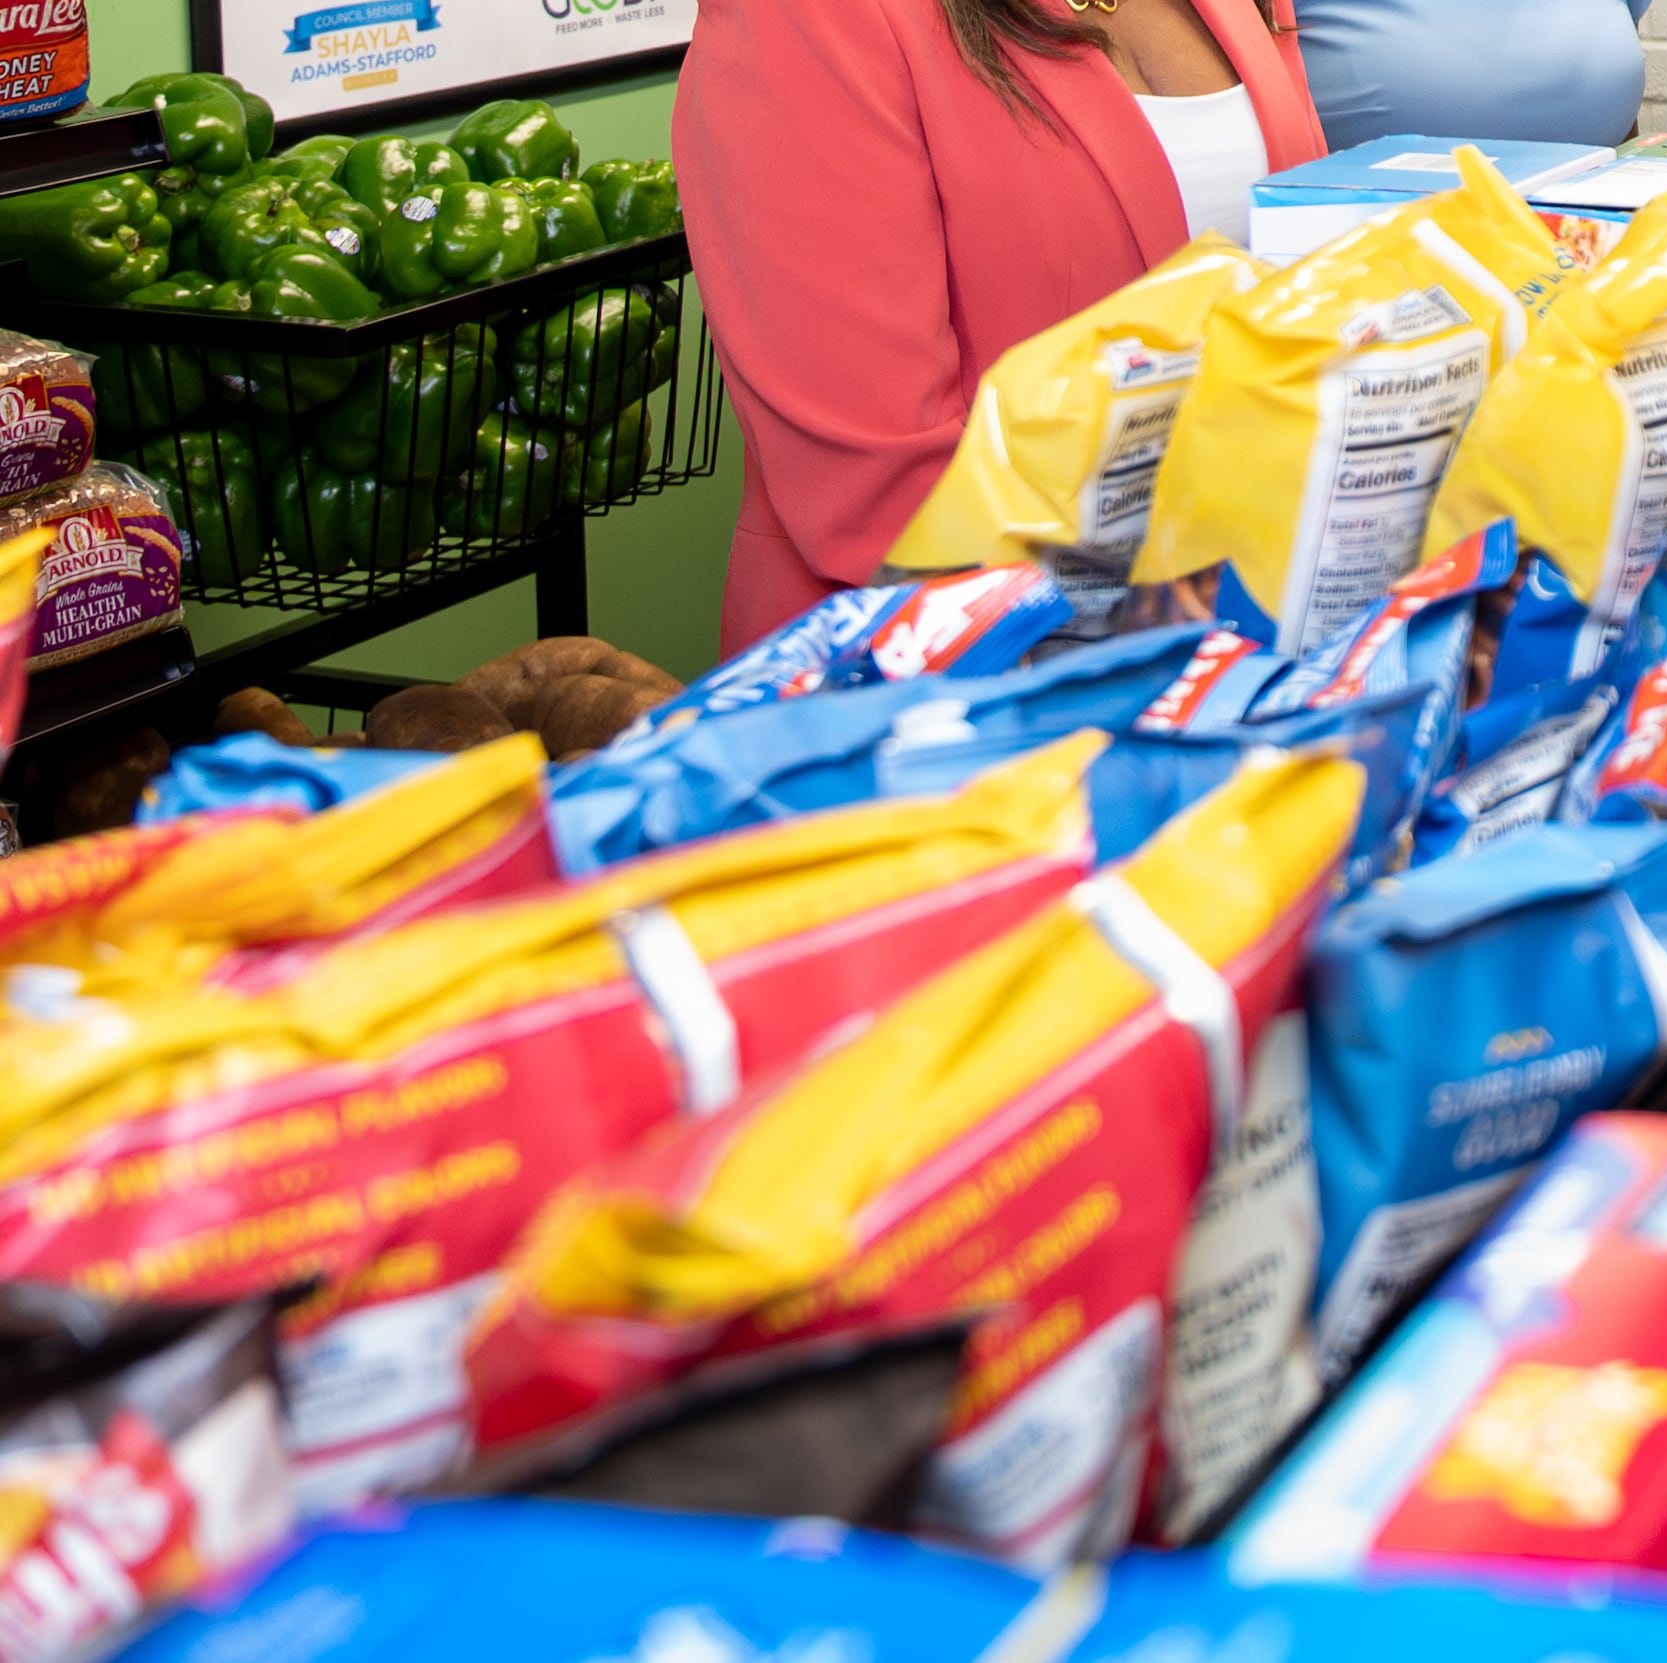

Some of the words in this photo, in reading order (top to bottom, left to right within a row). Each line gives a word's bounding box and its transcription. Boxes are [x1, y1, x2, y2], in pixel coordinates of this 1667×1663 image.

[314, 10, 364, 30] COUNCIL
[366, 3, 415, 21] MEMBER
[555, 23, 579, 35] FEED
[579, 17, 604, 31] MORE
[614, 10, 642, 24] WASTE
[644, 5, 665, 18] LESS
[317, 24, 411, 59] SHAYLA
[291, 43, 437, 83] ADAMS-STAFFORD
[1446, 357, 1481, 383] Facts
[1339, 463, 1418, 491] Calories
[49, 548, 124, 581] ARNOLD
[55, 588, 86, 611] Whole
[87, 580, 124, 601] Grains
[56, 592, 127, 628] HEALTHY
[42, 604, 142, 649] MULTI-GRAIN
